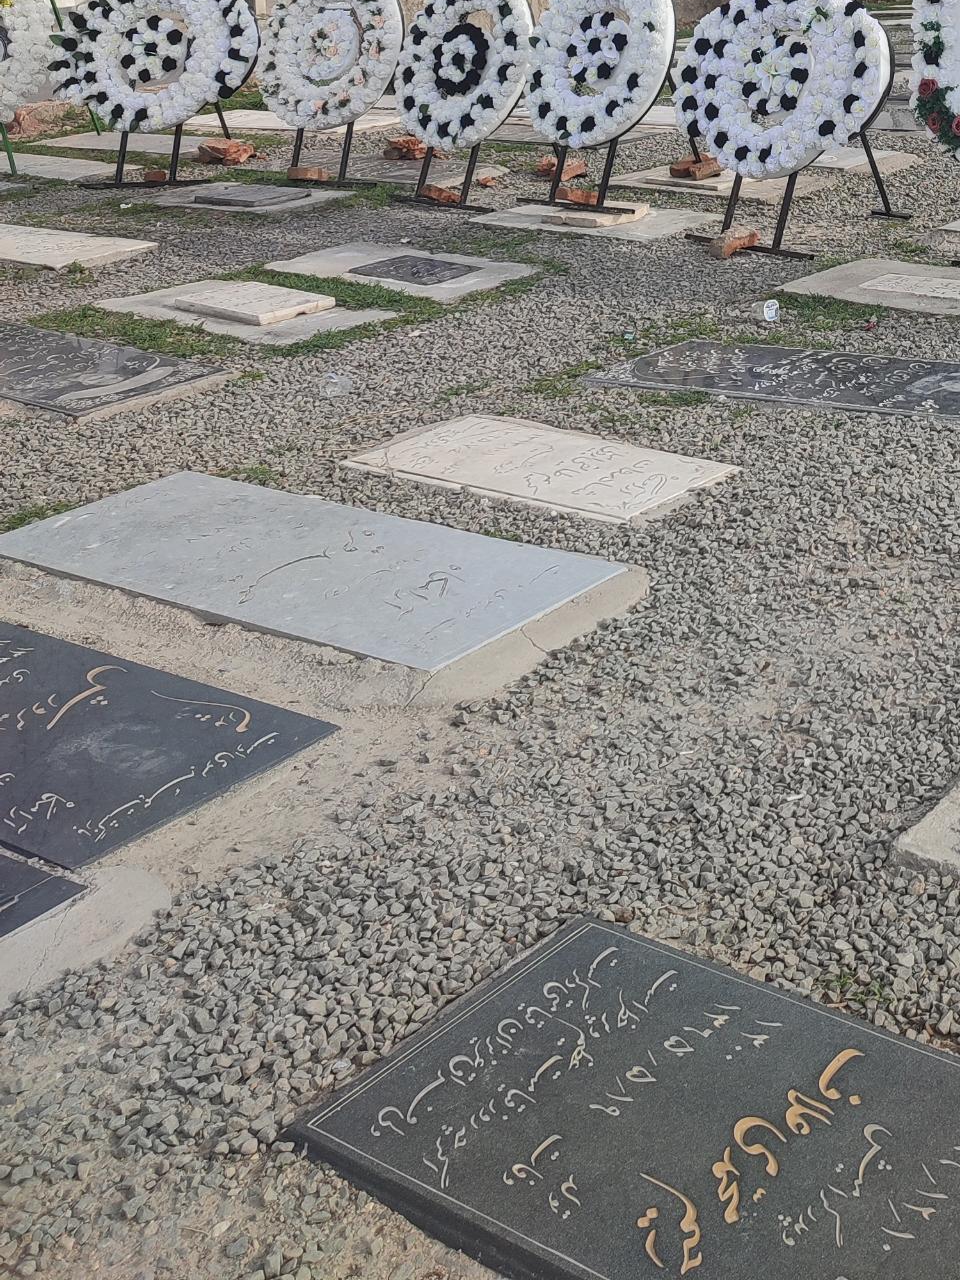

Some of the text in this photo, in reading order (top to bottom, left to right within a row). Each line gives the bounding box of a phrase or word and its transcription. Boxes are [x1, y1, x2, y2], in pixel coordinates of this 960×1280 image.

[384, 564, 464, 620] آرامگاه
[4, 792, 75, 835] آرامگاه
[371, 1105, 405, 1137] ولی
[407, 1054, 476, 1124] فراق
[470, 1019, 523, 1068] عزیزان
[518, 981, 574, 1029] قیامتی
[422, 1137, 450, 1189] اگر
[442, 1125, 466, 1149] چه
[470, 1098, 508, 1129] روز
[498, 1054, 563, 1112] قیامت
[618, 987, 641, 1030] خطر
[632, 970, 678, 1013] است
[549, 1019, 784, 1219] تولد ۱۳۰۰
[502, 1134, 563, 1186] وفات
[637, 1048, 865, 1275] رحیم علاف
[778, 1206, 816, 1234] پدر
[820, 1124, 892, 1247] گرامیش
